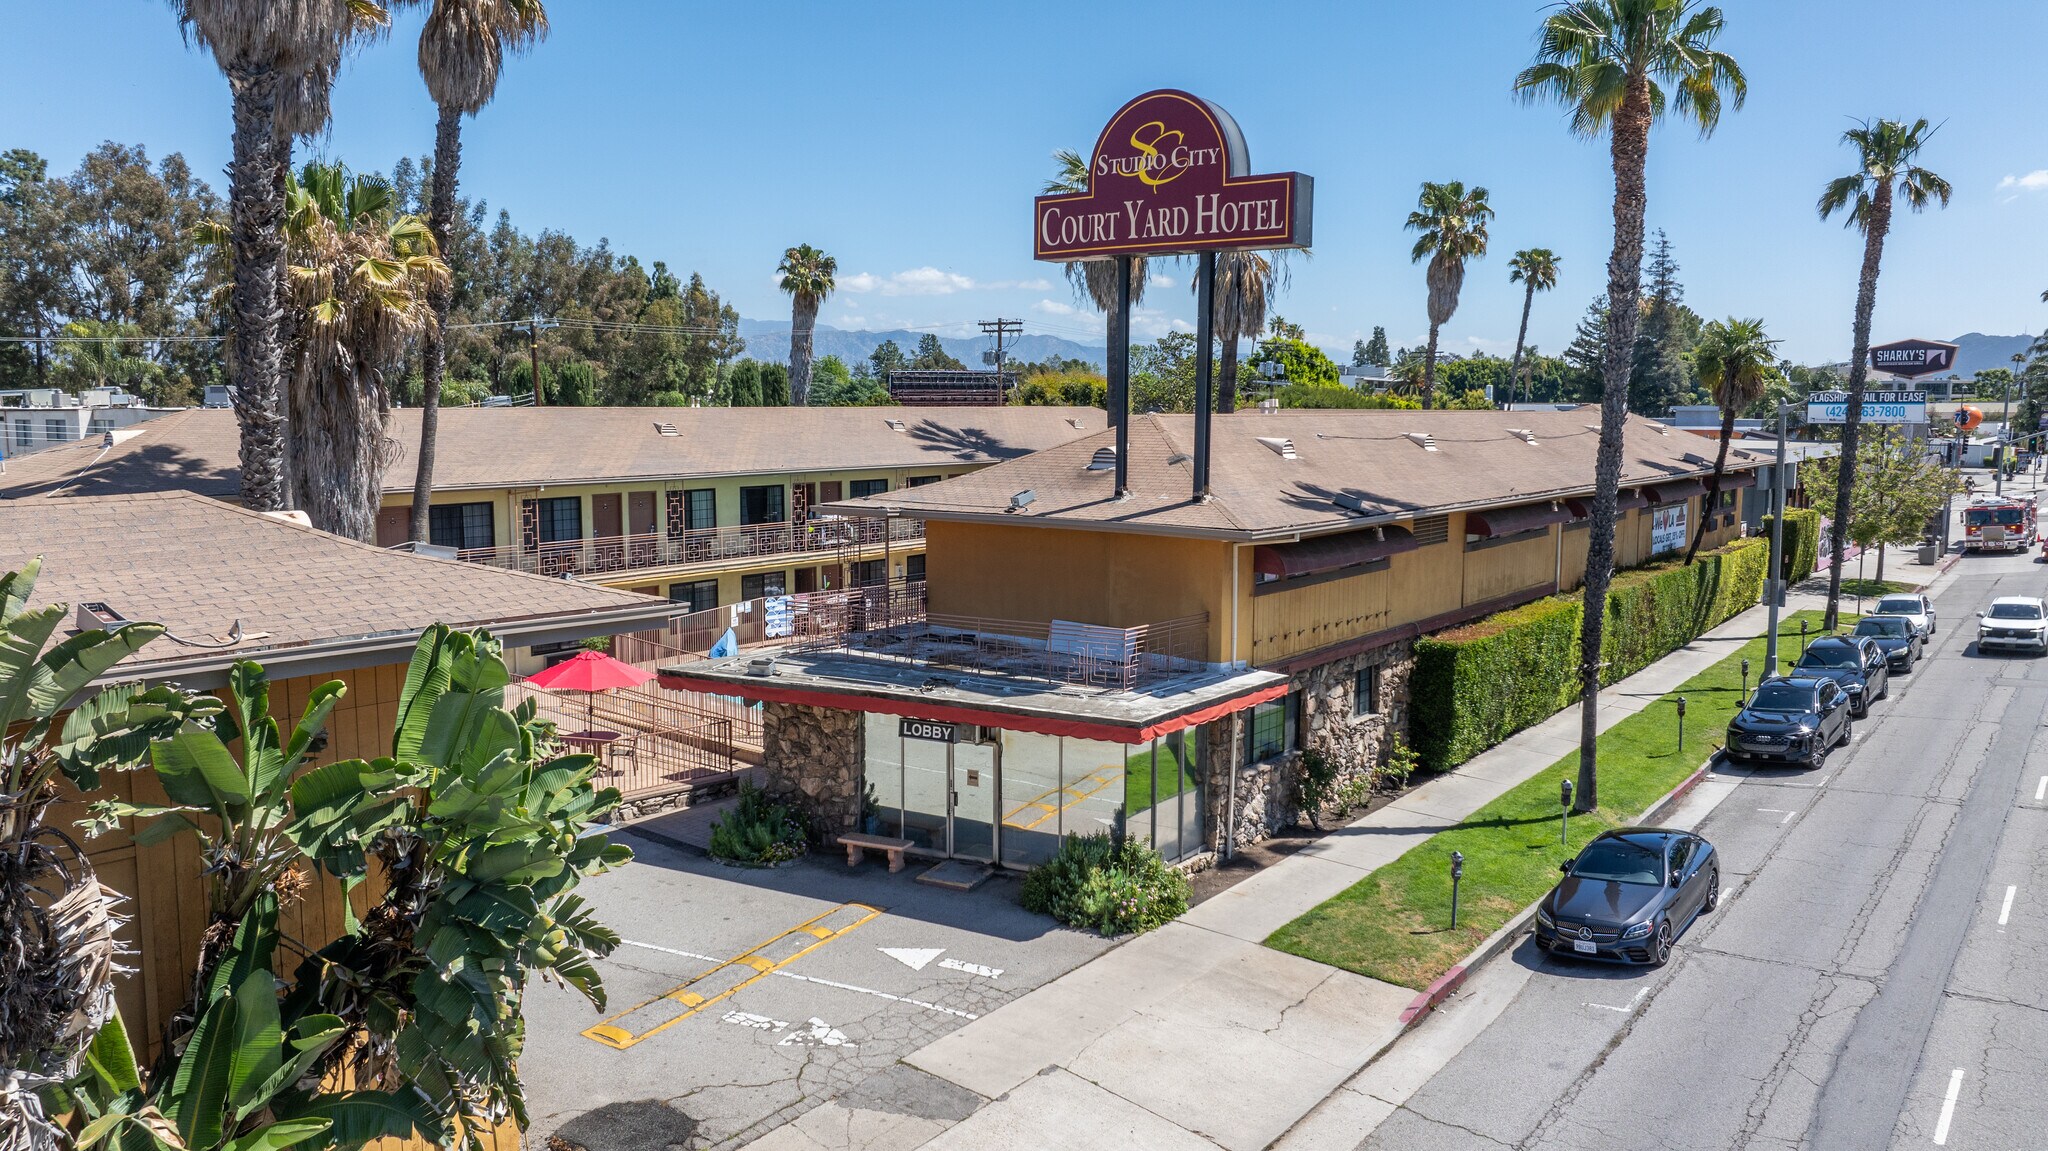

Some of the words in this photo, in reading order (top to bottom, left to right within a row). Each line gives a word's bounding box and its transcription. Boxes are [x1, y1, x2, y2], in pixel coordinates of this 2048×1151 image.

[1097, 152, 1167, 177] STUDIO
[1171, 145, 1221, 169] CITY
[1041, 207, 1120, 247] COURT
[1124, 199, 1189, 240] YARD
[1194, 193, 1284, 236] HOTEL
[1877, 349, 1925, 362] SHARKY'S
[1809, 392, 1848, 403] FLAGSHIP
[1879, 392, 1896, 402] FOR
[1898, 392, 1925, 402] LEASE
[902, 722, 952, 741] LOBBY
